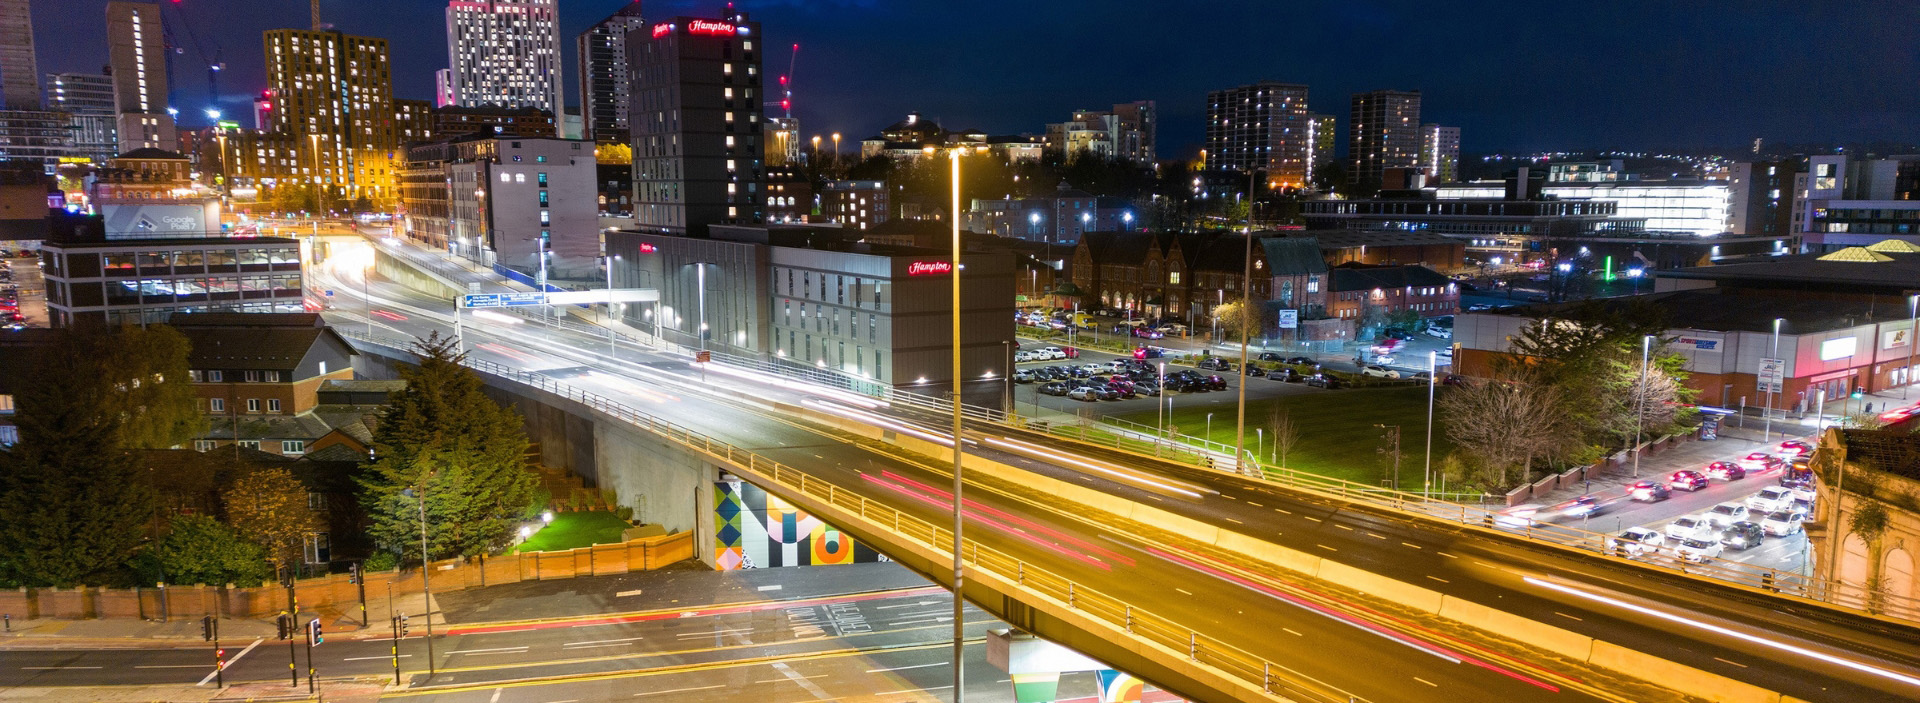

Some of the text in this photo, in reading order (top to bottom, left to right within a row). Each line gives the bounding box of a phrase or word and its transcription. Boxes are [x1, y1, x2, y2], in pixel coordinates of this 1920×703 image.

[688, 20, 735, 32] Hampton
[170, 222, 189, 230] Pixel
[909, 262, 951, 273] Hampton
